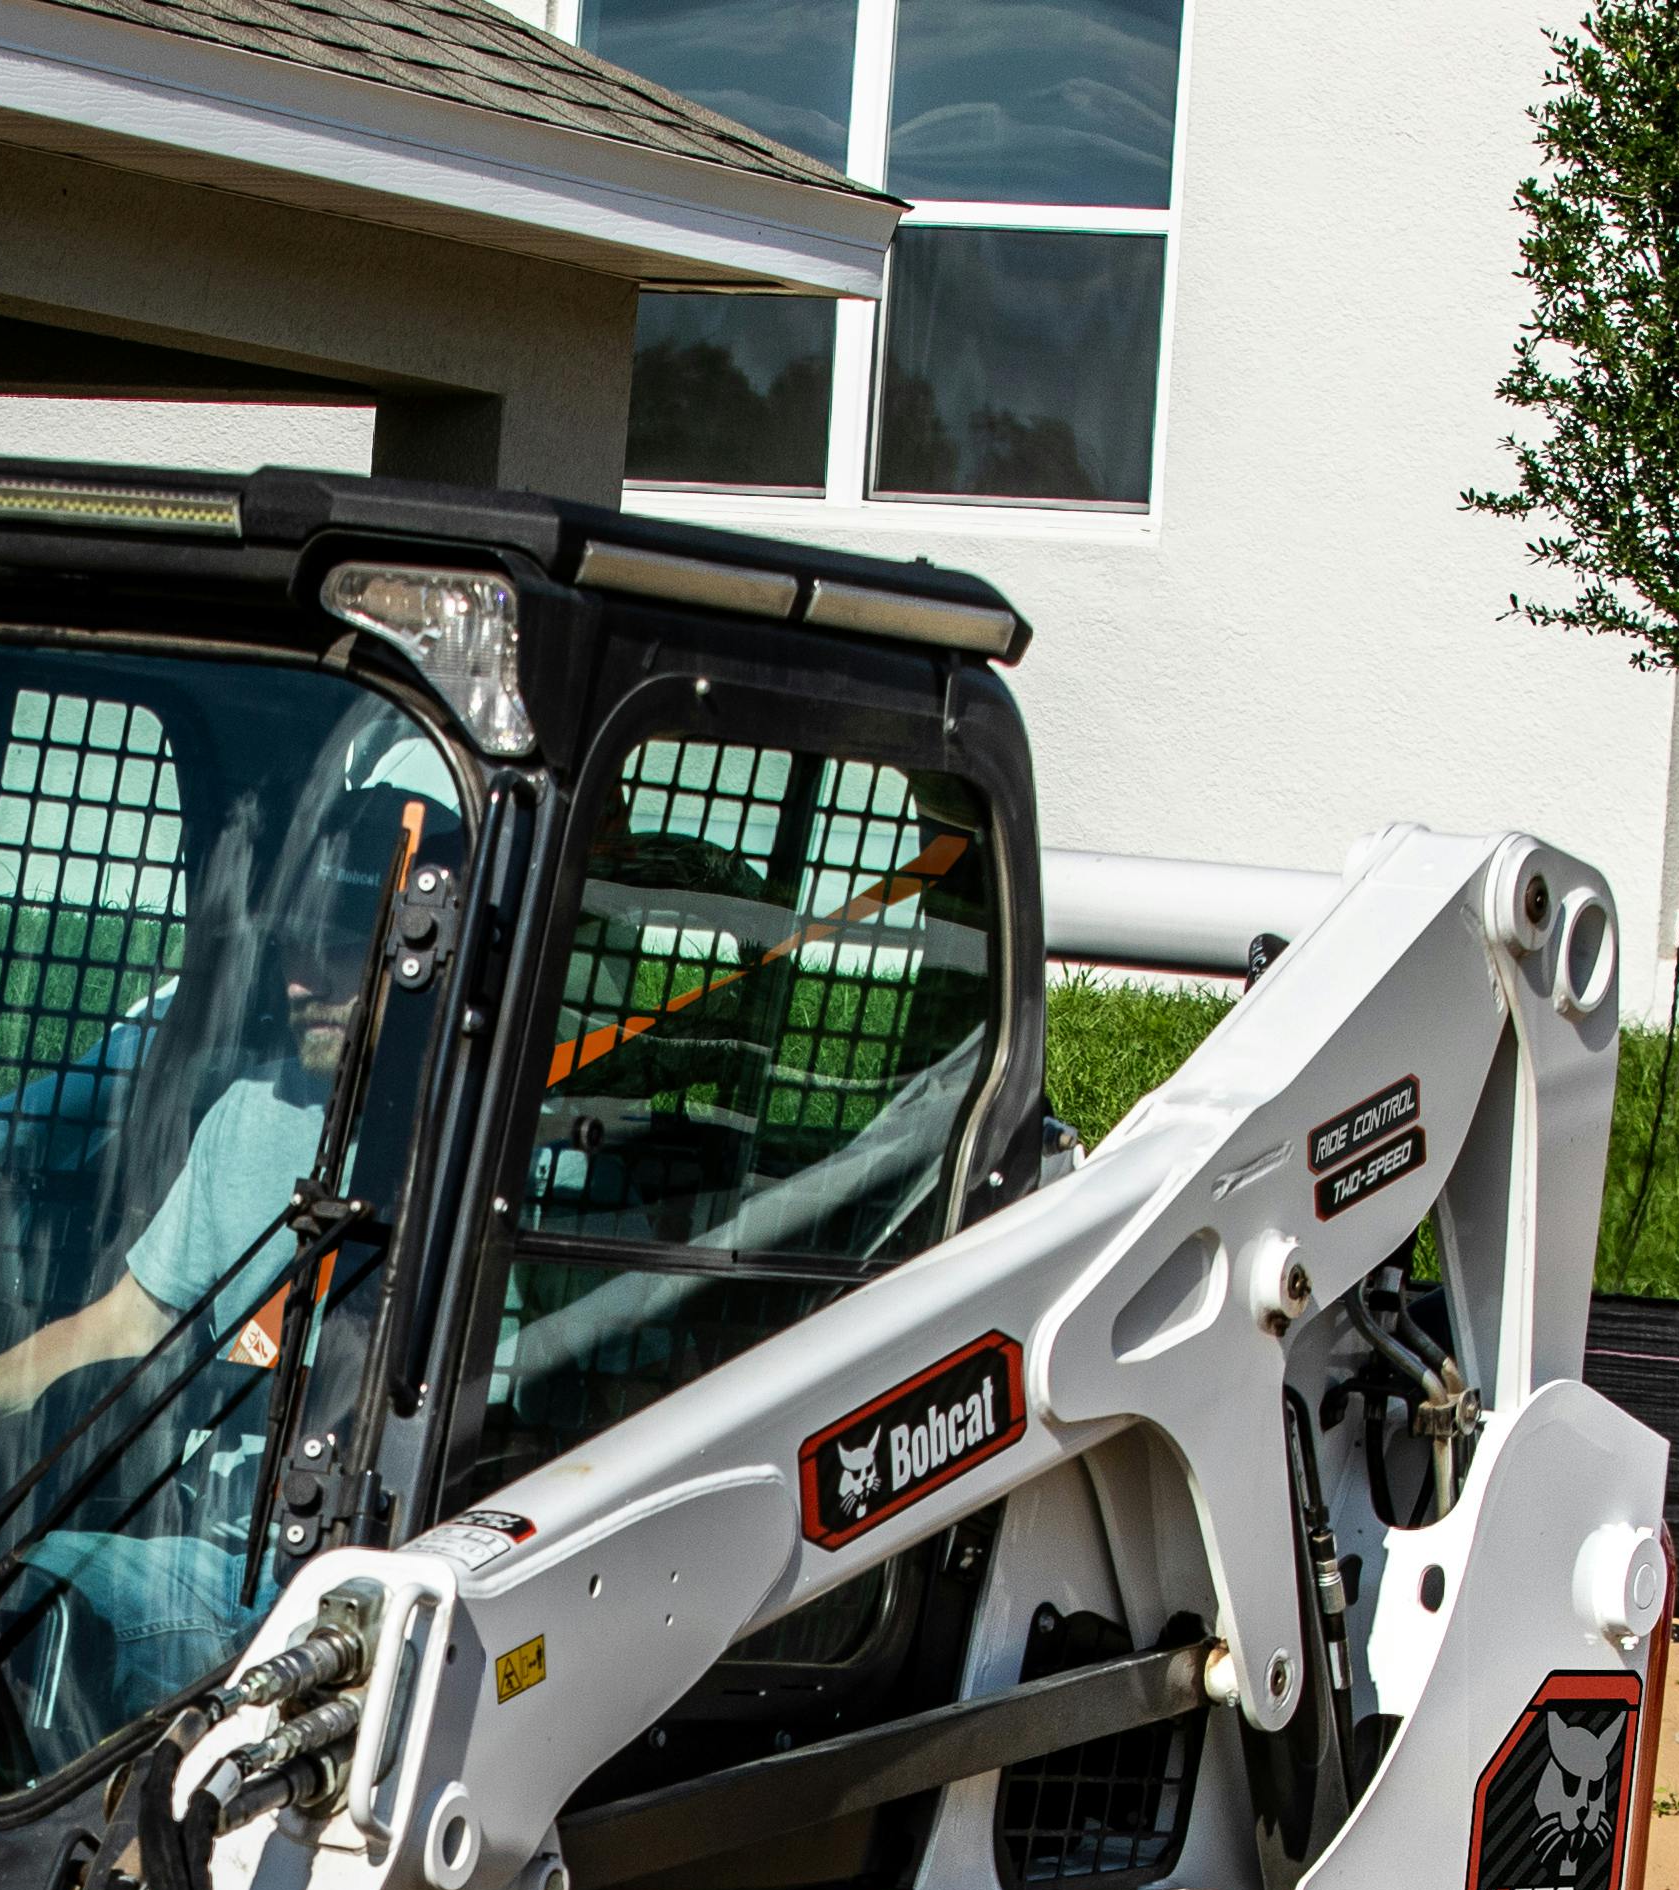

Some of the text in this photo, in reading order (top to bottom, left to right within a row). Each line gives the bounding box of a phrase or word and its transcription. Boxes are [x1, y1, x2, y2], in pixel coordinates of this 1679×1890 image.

[1315, 1086, 1416, 1164] RIDE CONTROL
[1332, 1139, 1412, 1204] TWO-SPEED
[889, 1375, 997, 1492] Bobcat
